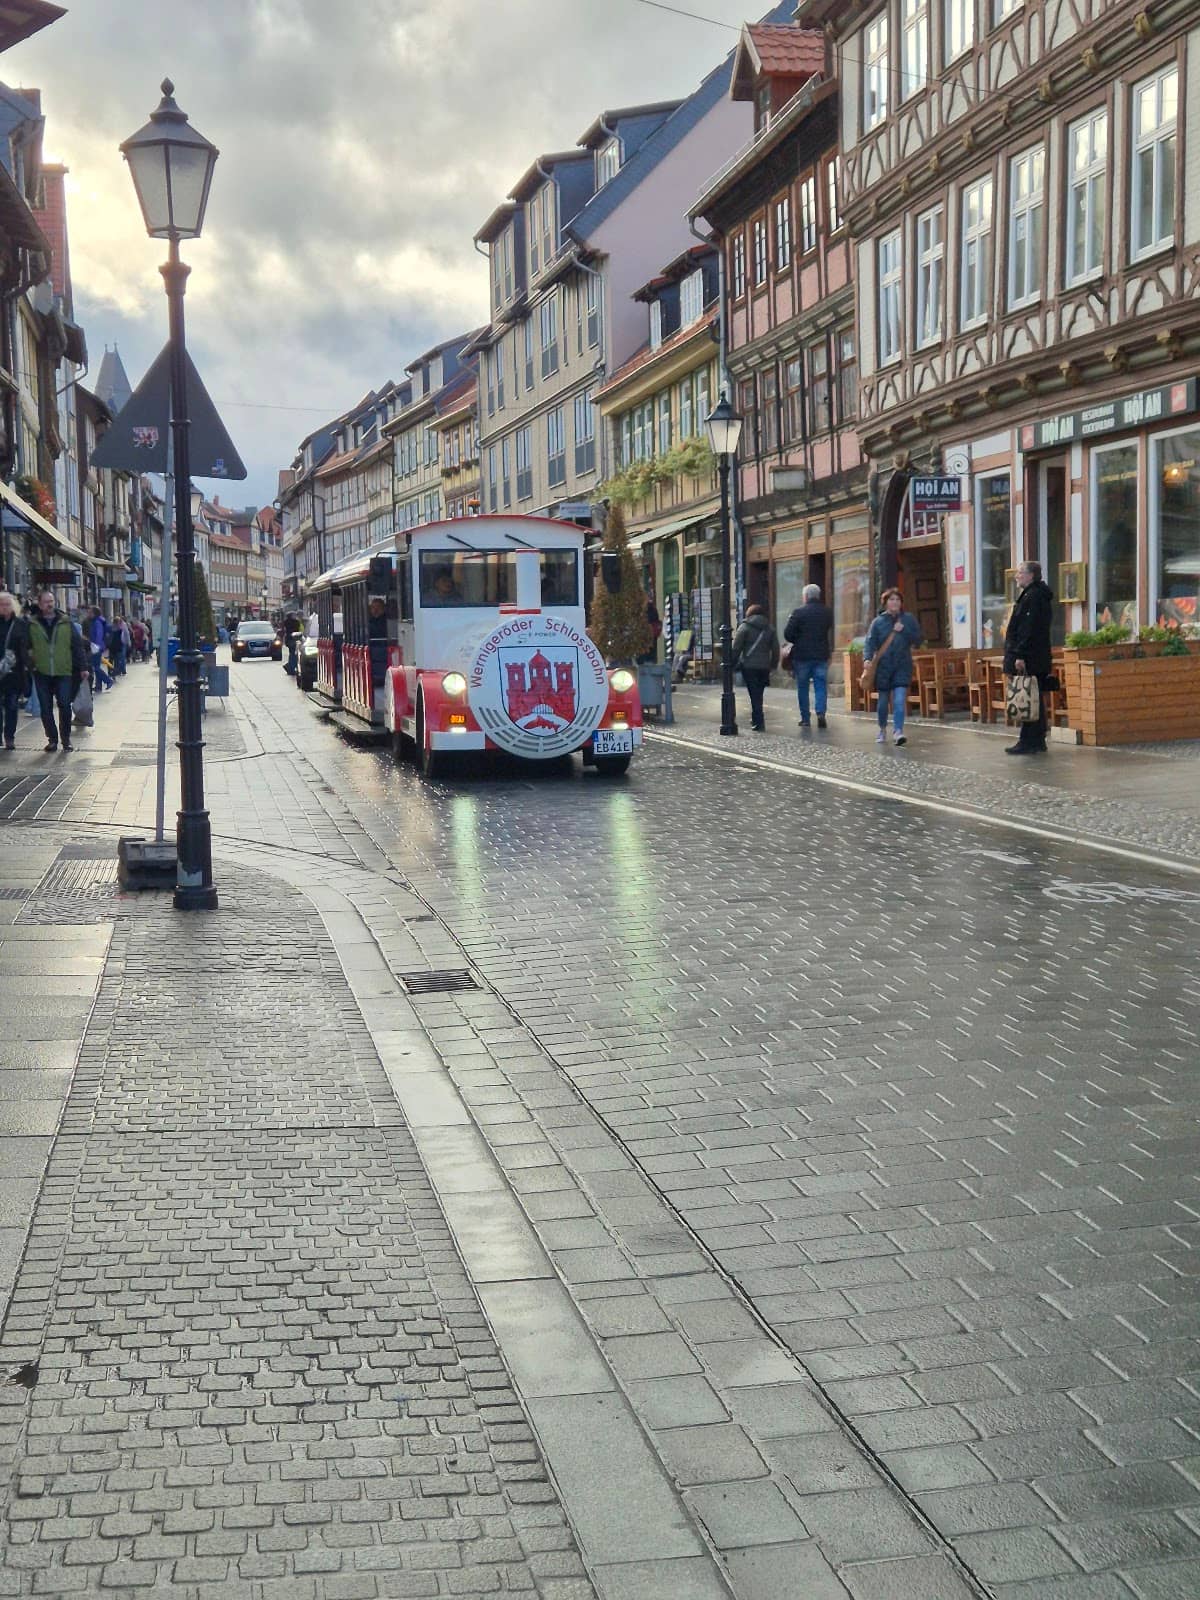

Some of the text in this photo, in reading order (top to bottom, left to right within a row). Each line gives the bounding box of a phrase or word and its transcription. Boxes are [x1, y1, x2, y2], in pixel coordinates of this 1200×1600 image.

[1145, 392, 1162, 418] AN
[1060, 416, 1074, 439] AN
[941, 481, 959, 495] AN
[470, 618, 605, 688] Wernigeröder Schlossbahn
[602, 732, 615, 741] WR
